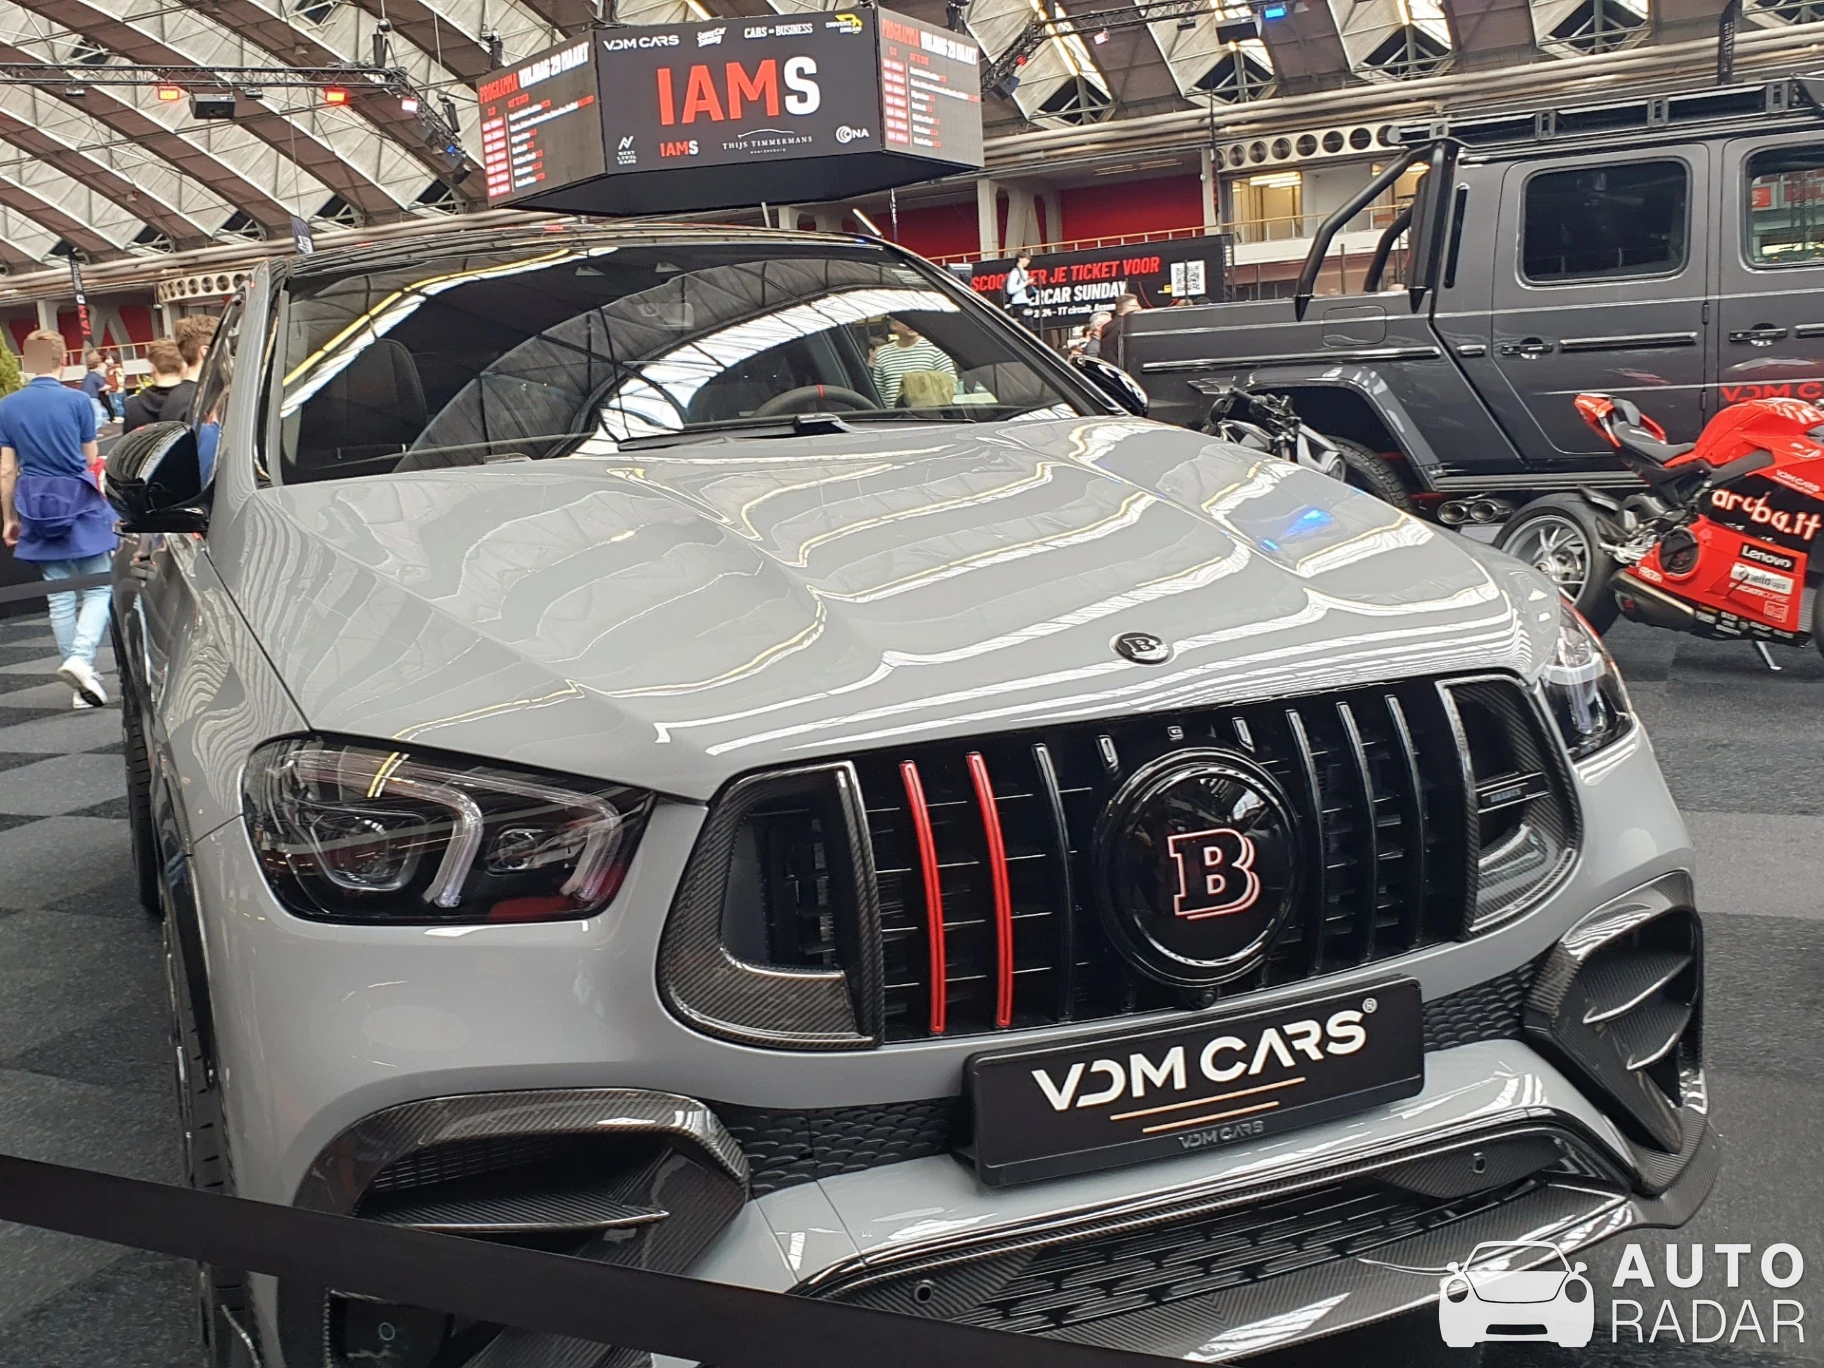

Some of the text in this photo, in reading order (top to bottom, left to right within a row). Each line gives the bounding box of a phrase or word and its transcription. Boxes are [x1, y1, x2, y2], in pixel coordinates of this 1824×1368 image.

[744, 26, 768, 39] CARS
[775, 23, 813, 36] BUSINESS
[603, 34, 680, 51] VDM CARS
[656, 55, 821, 126] IAMS
[660, 140, 699, 157] IAMS
[722, 135, 813, 150] THIJS TIMMERMANS
[1049, 265, 1068, 284] JE
[1070, 259, 1120, 281] TICKET
[1122, 256, 1160, 276] VOOR
[1073, 280, 1127, 301] SUNDAY
[1720, 383, 1791, 402] VDM
[1741, 544, 1792, 568] Lenovo
[1121, 636, 1160, 658] B
[1167, 827, 1261, 920] B
[1031, 1045, 1188, 1112] VDM
[1178, 1120, 1264, 1148] VDM CARS
